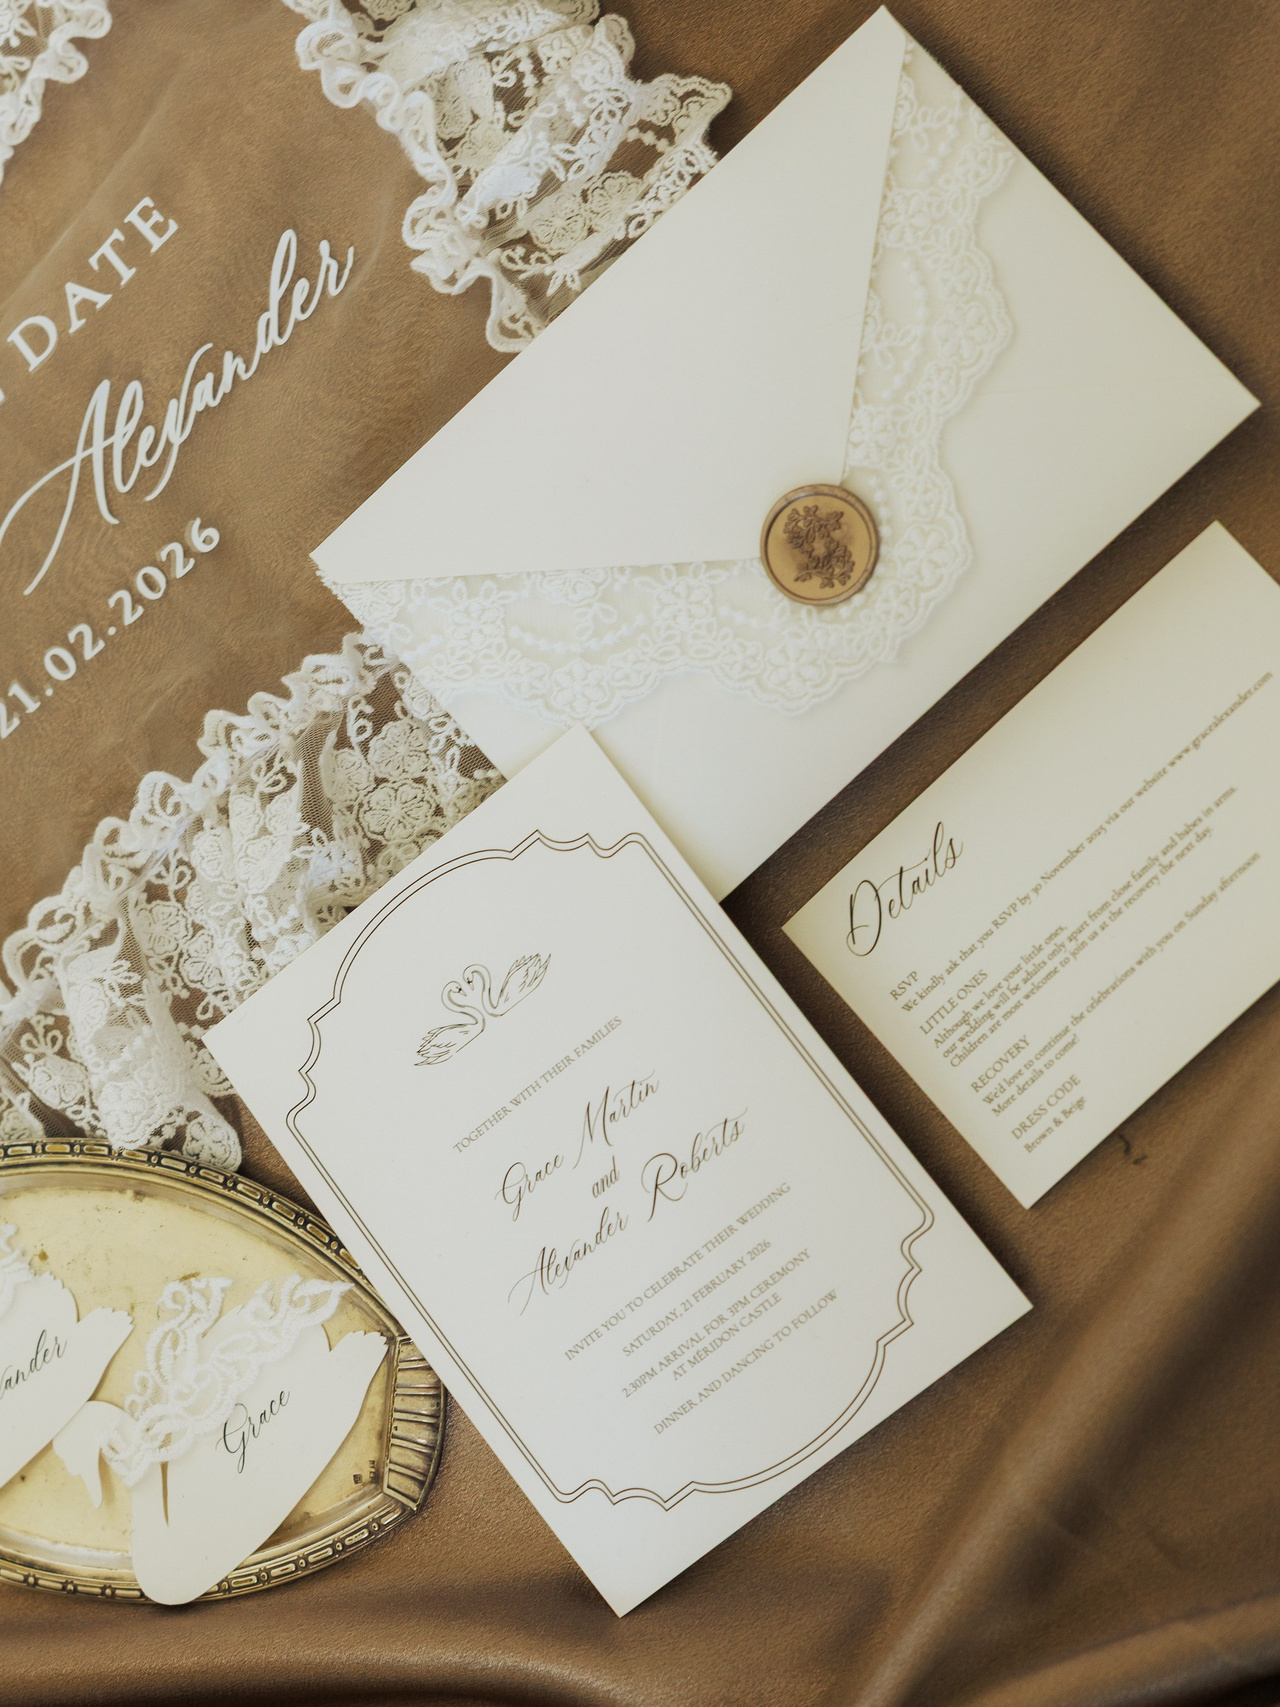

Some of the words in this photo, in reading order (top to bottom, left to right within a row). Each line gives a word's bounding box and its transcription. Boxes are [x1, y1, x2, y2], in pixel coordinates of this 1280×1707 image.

[7, 196, 179, 371] DATE
[846, 821, 963, 956] Details
[901, 999, 918, 1011] We
[915, 974, 945, 1000] kindly
[945, 960, 960, 975] ask
[959, 943, 978, 961] that
[977, 928, 994, 948] you
[991, 902, 1018, 929] RSVP
[1016, 893, 1031, 906] by
[1031, 883, 1042, 896] 30
[1040, 843, 1085, 884] November
[1086, 824, 1107, 844] 2025
[1105, 812, 1120, 825] via
[1119, 797, 1135, 813] our
[1135, 767, 1168, 797] website
[943, 1043, 957, 1058] our
[958, 1010, 995, 1049] wedding
[992, 991, 1010, 1010] will
[1007, 983, 1021, 995] be
[1022, 960, 1047, 985] adults
[1047, 941, 1066, 960] only
[1067, 920, 1089, 943] apart
[1087, 901, 1111, 922] from
[1111, 880, 1132, 902] close
[1131, 855, 1162, 882] family
[1161, 836, 1178, 856] and
[1174, 817, 1203, 840] babes
[1201, 807, 1214, 818] in
[890, 971, 918, 1000] RSVP
[919, 997, 958, 1035] LITTLE
[957, 969, 988, 1000] ONES
[934, 1010, 973, 1048] Although
[972, 999, 985, 1011] we
[982, 982, 1003, 1000] love
[1003, 963, 1027, 988] your
[1020, 944, 1044, 964] little
[1044, 926, 1067, 945] ones,
[950, 1033, 988, 1067] Children
[988, 1017, 1002, 1034] are
[1002, 1000, 1023, 1021] most
[1023, 966, 1059, 1000] welcome
[1059, 957, 1070, 967] to
[1069, 940, 1088, 960] join
[1088, 930, 1099, 941] us
[1099, 921, 1109, 932] at
[1108, 907, 1124, 922] the
[1123, 874, 1160, 908] recovery
[1158, 860, 1175, 875] the
[1175, 842, 1195, 861] next
[1003, 1069, 1024, 1087] love
[1023, 1060, 1034, 1070] to
[1035, 1025, 1071, 1061] continue
[1070, 1012, 1086, 1026] the
[1086, 966, 1136, 1013] celebrations
[1135, 946, 1157, 966] with
[1155, 932, 1174, 951] you
[1173, 920, 1186, 933] on
[1184, 891, 1218, 921] Sunday
[453, 1106, 512, 1153] TOGETHER
[509, 1080, 541, 1106] WITH
[539, 1055, 575, 1083] THEIR
[573, 1016, 622, 1057] FAMILIES
[971, 1035, 1029, 1093] RECOVERY
[992, 1094, 1016, 1116] More
[1016, 1069, 1044, 1095] details
[1043, 1059, 1055, 1070] to
[1055, 1032, 1079, 1060] come!
[1011, 1104, 1048, 1140] DRESS
[1046, 1074, 1081, 1107] CODE
[1024, 1127, 1054, 1153] Brown
[1053, 1117, 1063, 1127] &
[1061, 1096, 1086, 1119] Beige
[494, 1154, 564, 1222] Grace
[572, 1069, 660, 1169] Martin
[591, 1155, 620, 1198] and
[507, 1206, 629, 1317] Alexander
[641, 1107, 748, 1222] Roberts
[565, 1328, 603, 1361] INVITE
[601, 1309, 626, 1331] YOU
[625, 1296, 643, 1312] TO
[644, 1250, 704, 1299] CELEBRATE
[702, 1225, 738, 1253] THEIR
[736, 1182, 791, 1225] WEDDING
[622, 1308, 683, 1356] SATURDAY,
[680, 1299, 693, 1312] 21
[692, 1256, 746, 1303] FEBRUARY
[746, 1239, 771, 1261] 2026
[658, 1333, 705, 1371] ARRIVAL
[703, 1314, 729, 1335] FOR
[727, 1296, 750, 1316] 3PM
[750, 1248, 810, 1299] CEREMONY
[673, 1363, 687, 1381] AT
[739, 1292, 782, 1327] CASTLE
[654, 1399, 698, 1434] DINNER
[698, 1379, 722, 1402] AND
[721, 1339, 774, 1383] DANCING
[772, 1326, 791, 1342] TO
[791, 1289, 837, 1329] FOLLOW
[215, 1389, 291, 1474] Grace
